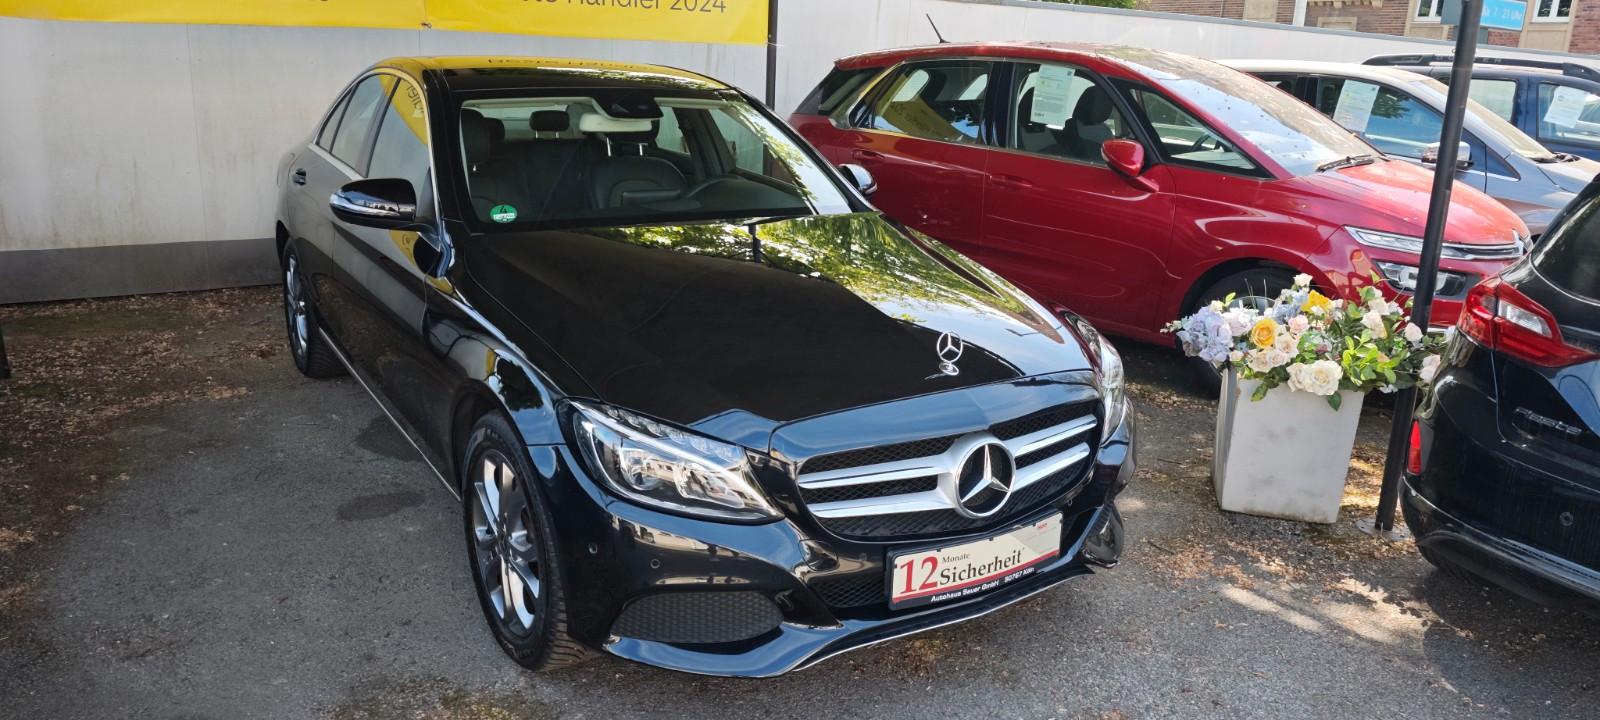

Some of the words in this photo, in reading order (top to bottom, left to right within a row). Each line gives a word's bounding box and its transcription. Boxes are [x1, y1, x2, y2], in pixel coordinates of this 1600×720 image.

[669, 0, 726, 13] 2024
[1436, 55, 1502, 63] DUER
[942, 552, 971, 564] Monate
[900, 556, 939, 594] 12
[930, 591, 962, 602] Autohaus
[962, 586, 981, 596] Sauer
[981, 580, 1000, 590] GmbH
